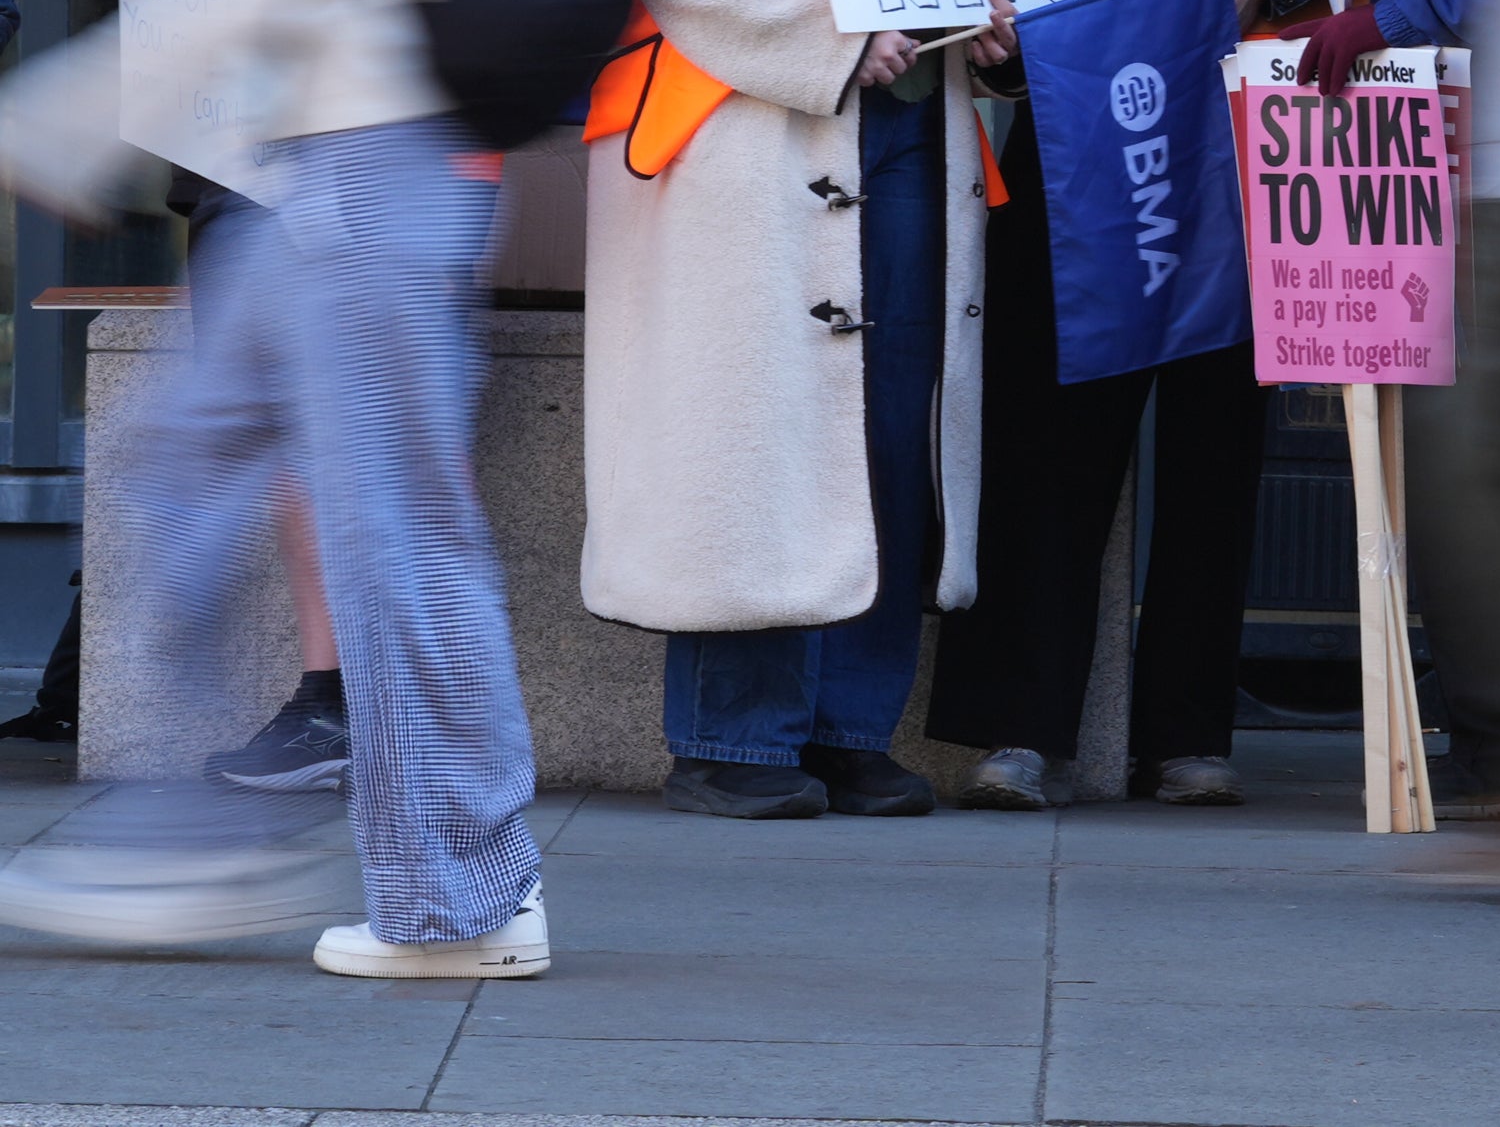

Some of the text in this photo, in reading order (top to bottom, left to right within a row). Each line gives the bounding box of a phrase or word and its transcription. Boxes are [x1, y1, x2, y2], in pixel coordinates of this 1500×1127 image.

[1353, 58, 1416, 84] Worker
[1259, 93, 1437, 169] STRIKE
[1122, 134, 1182, 298] BMA
[1259, 172, 1443, 247] TO WIN
[1271, 259, 1394, 290] We all need
[1274, 293, 1377, 329] a pay rise
[1276, 335, 1432, 374] Strike together
